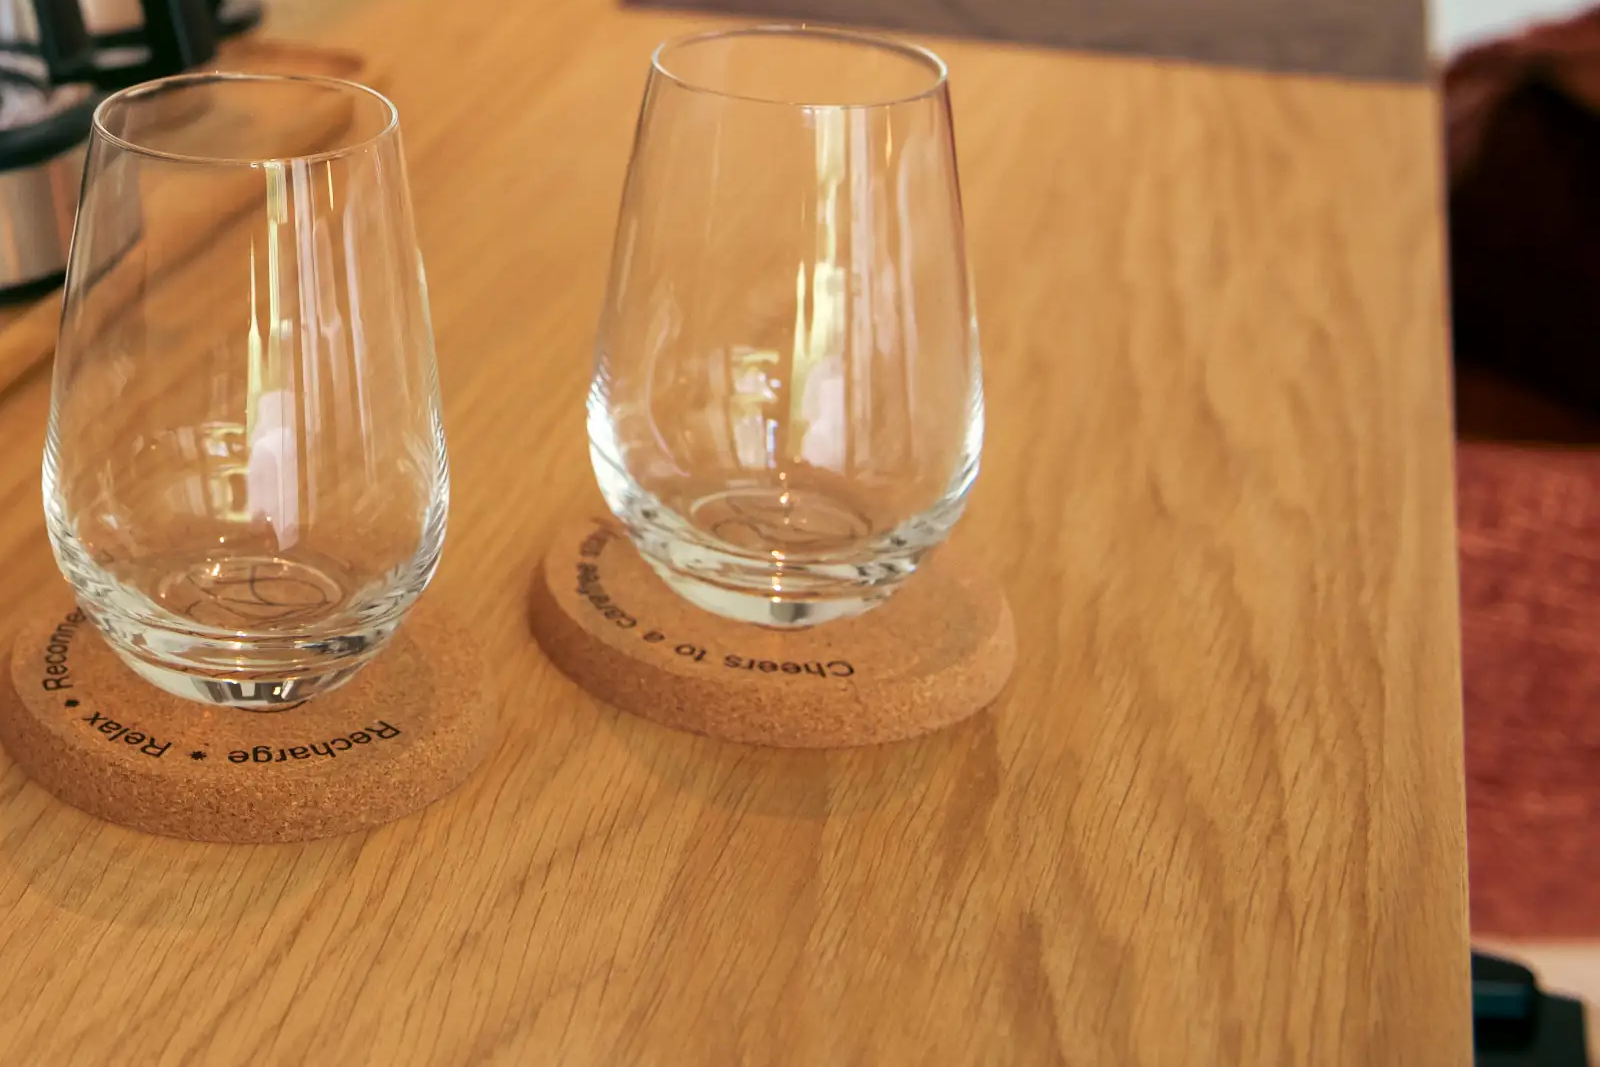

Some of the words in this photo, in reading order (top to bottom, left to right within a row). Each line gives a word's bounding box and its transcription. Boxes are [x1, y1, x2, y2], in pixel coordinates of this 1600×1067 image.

[42, 605, 87, 691] Reconne
[674, 640, 707, 662] to
[723, 652, 855, 678] Cheers
[82, 710, 173, 758] Relax
[228, 720, 402, 763] Recharge
